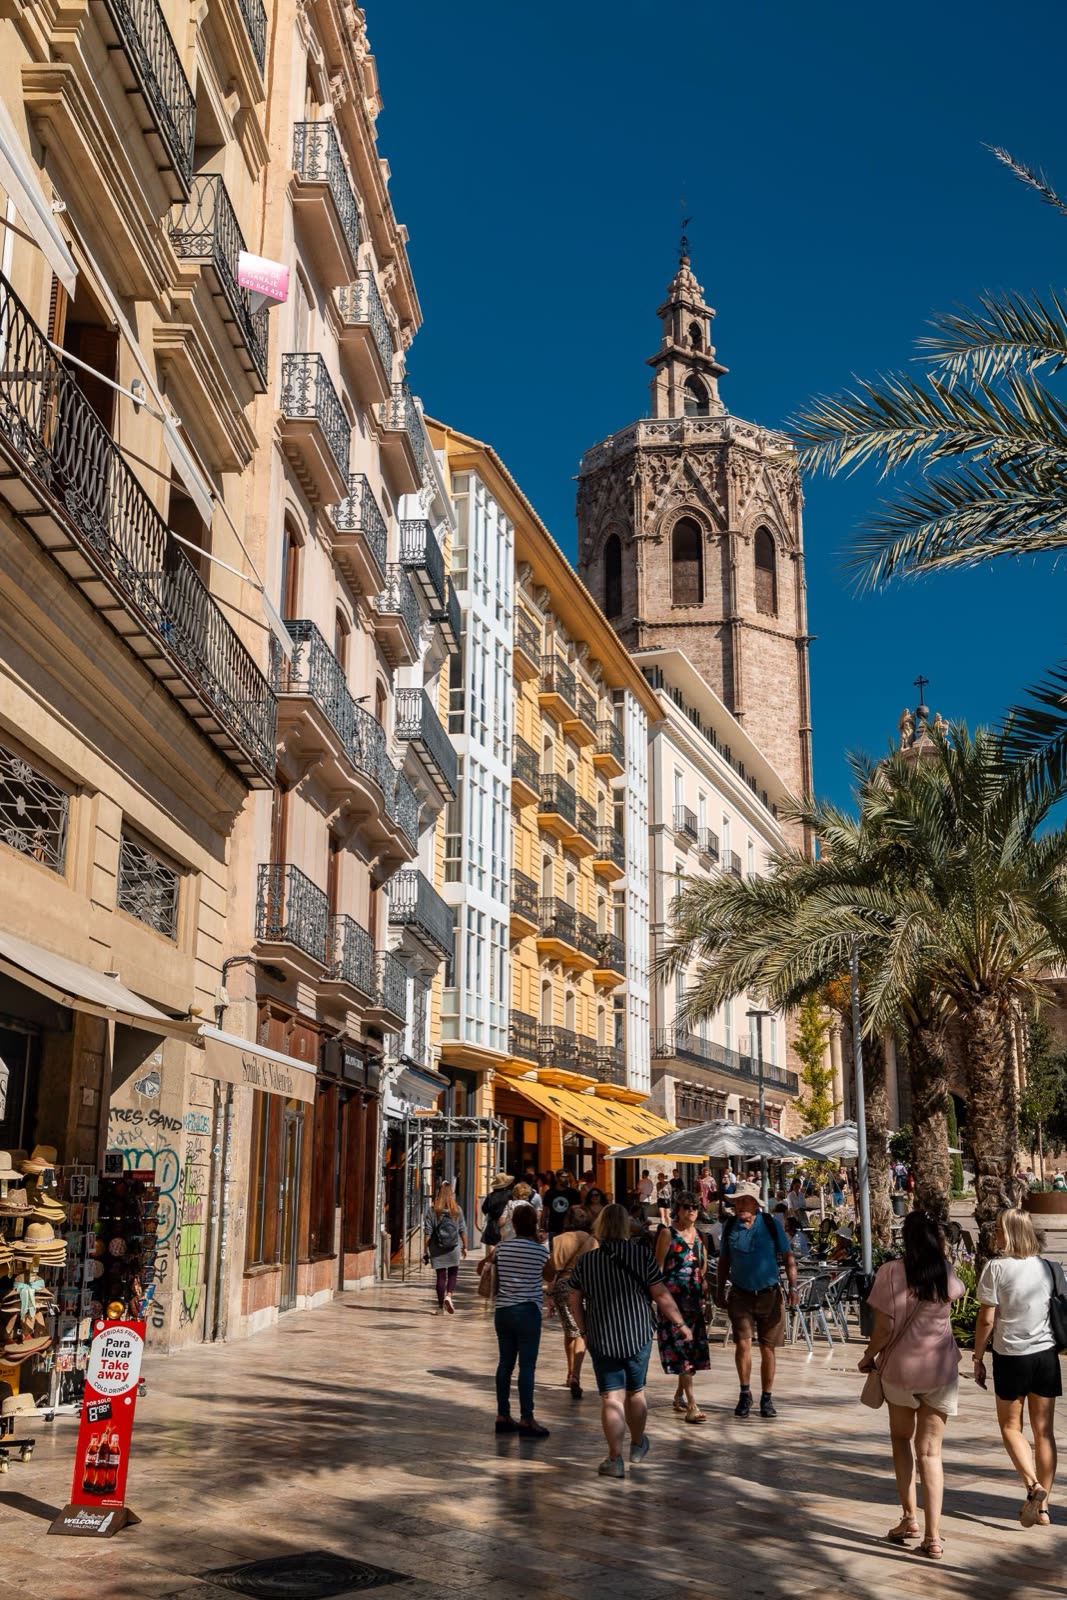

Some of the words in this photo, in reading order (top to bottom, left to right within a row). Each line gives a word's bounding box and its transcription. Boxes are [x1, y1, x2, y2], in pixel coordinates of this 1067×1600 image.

[106, 1337, 131, 1349] Para
[101, 1347, 133, 1359] llevar
[100, 1359, 130, 1371] Take
[97, 1370, 130, 1383] away
[93, 1381, 108, 1393] COLD
[108, 1383, 130, 1394] DRINKS
[97, 1397, 112, 1405] SOLO
[63, 1517, 103, 1526] WELCOME
